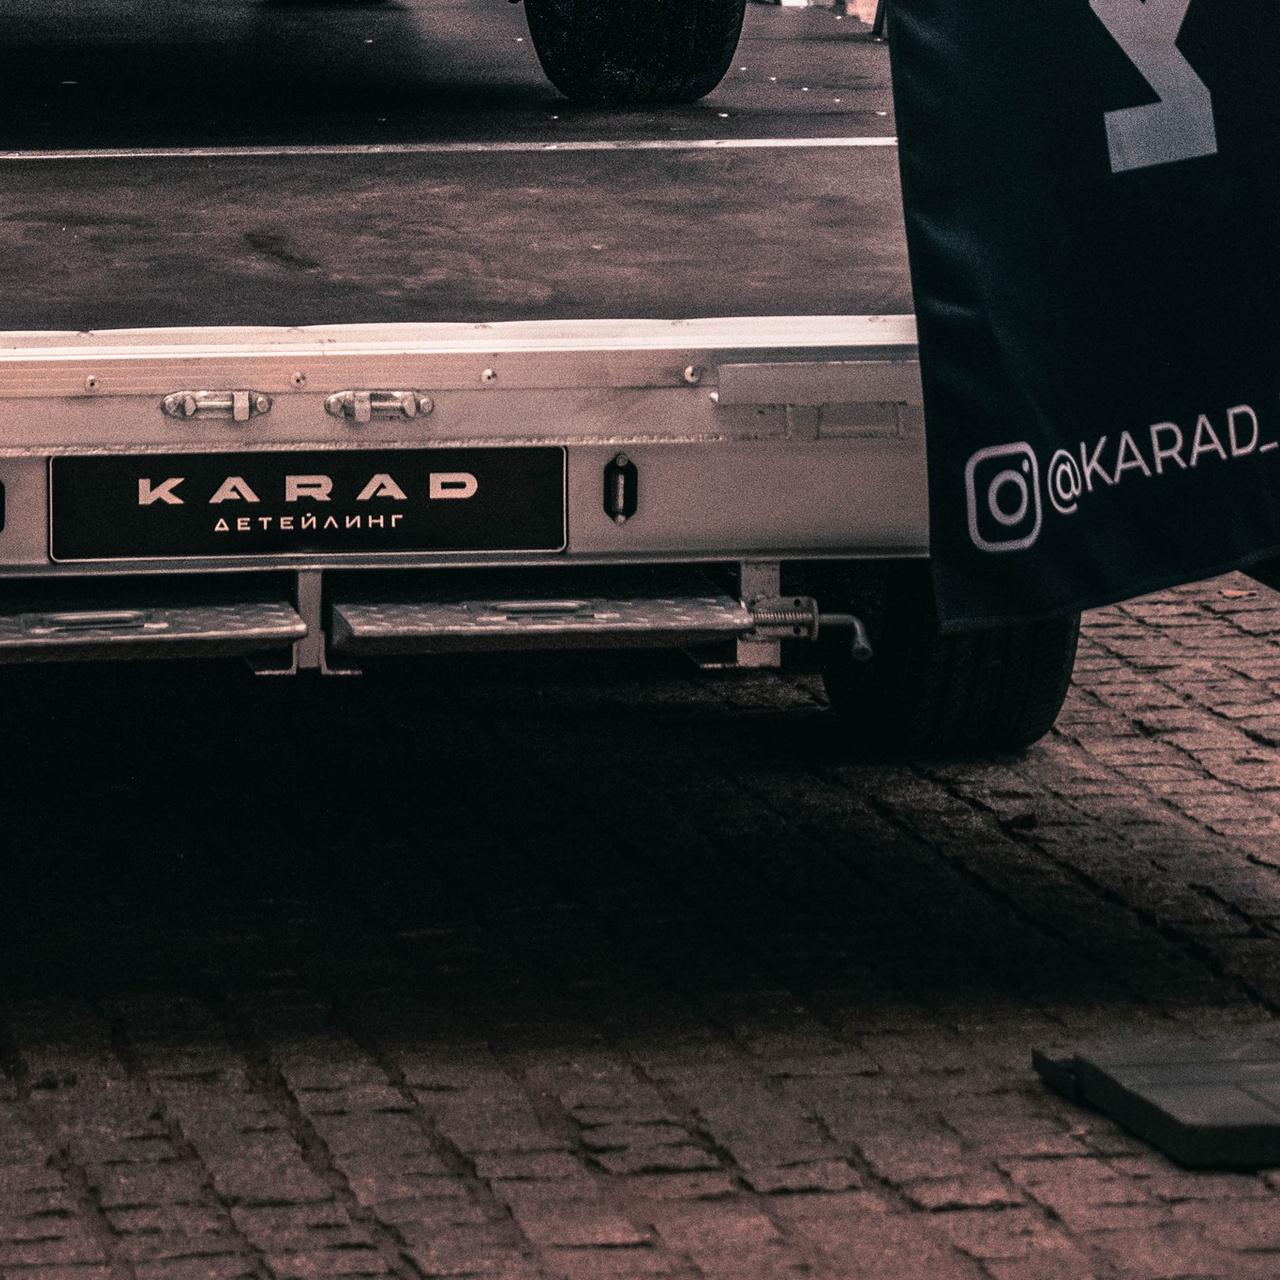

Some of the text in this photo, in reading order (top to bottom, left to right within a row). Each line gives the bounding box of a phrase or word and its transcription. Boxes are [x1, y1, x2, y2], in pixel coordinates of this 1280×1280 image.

[1047, 403, 1279, 515] @KARAD_
[138, 472, 479, 505] KARAD
[214, 512, 404, 532] ДЕТЕЙЛИНГ
